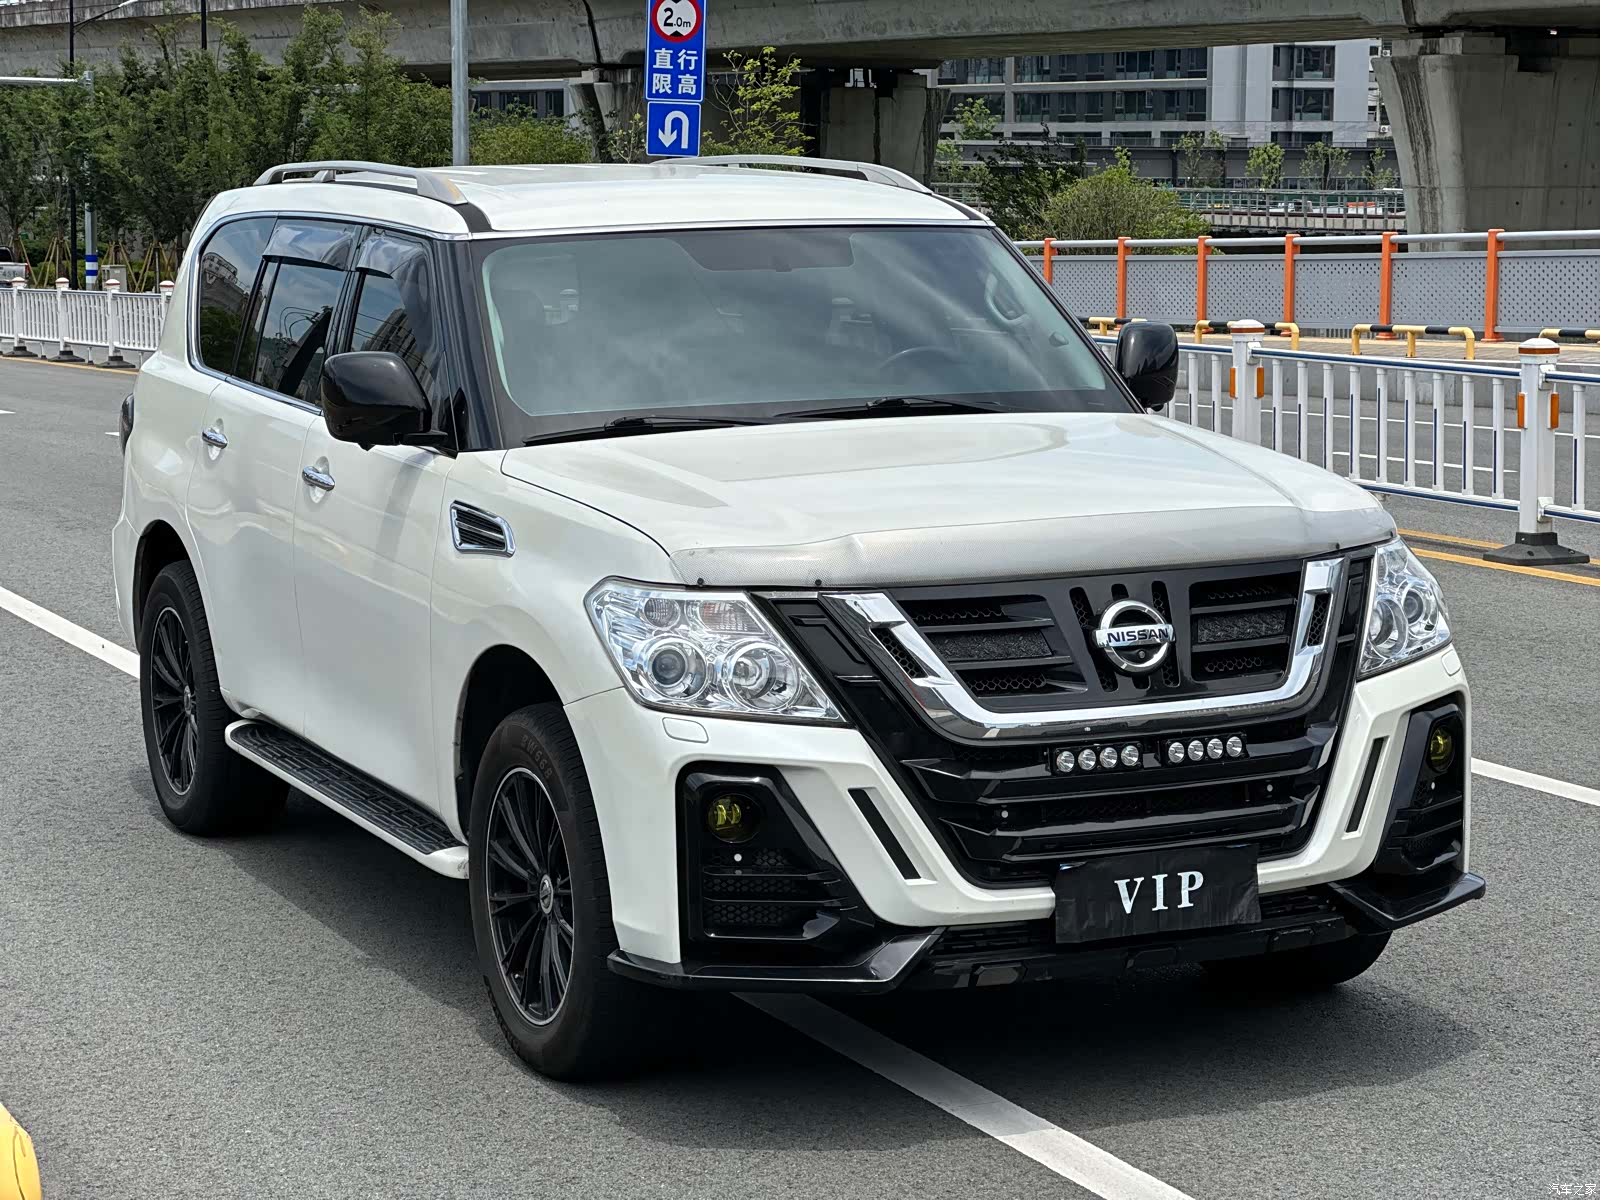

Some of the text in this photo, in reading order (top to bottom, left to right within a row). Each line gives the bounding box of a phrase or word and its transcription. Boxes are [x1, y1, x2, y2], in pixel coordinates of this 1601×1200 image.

[663, 7, 691, 28] 2.0m
[653, 48, 698, 70] 直行
[652, 73, 697, 95] 限高
[1107, 628, 1169, 643] NISSAN
[1114, 870, 1204, 914] VIP
